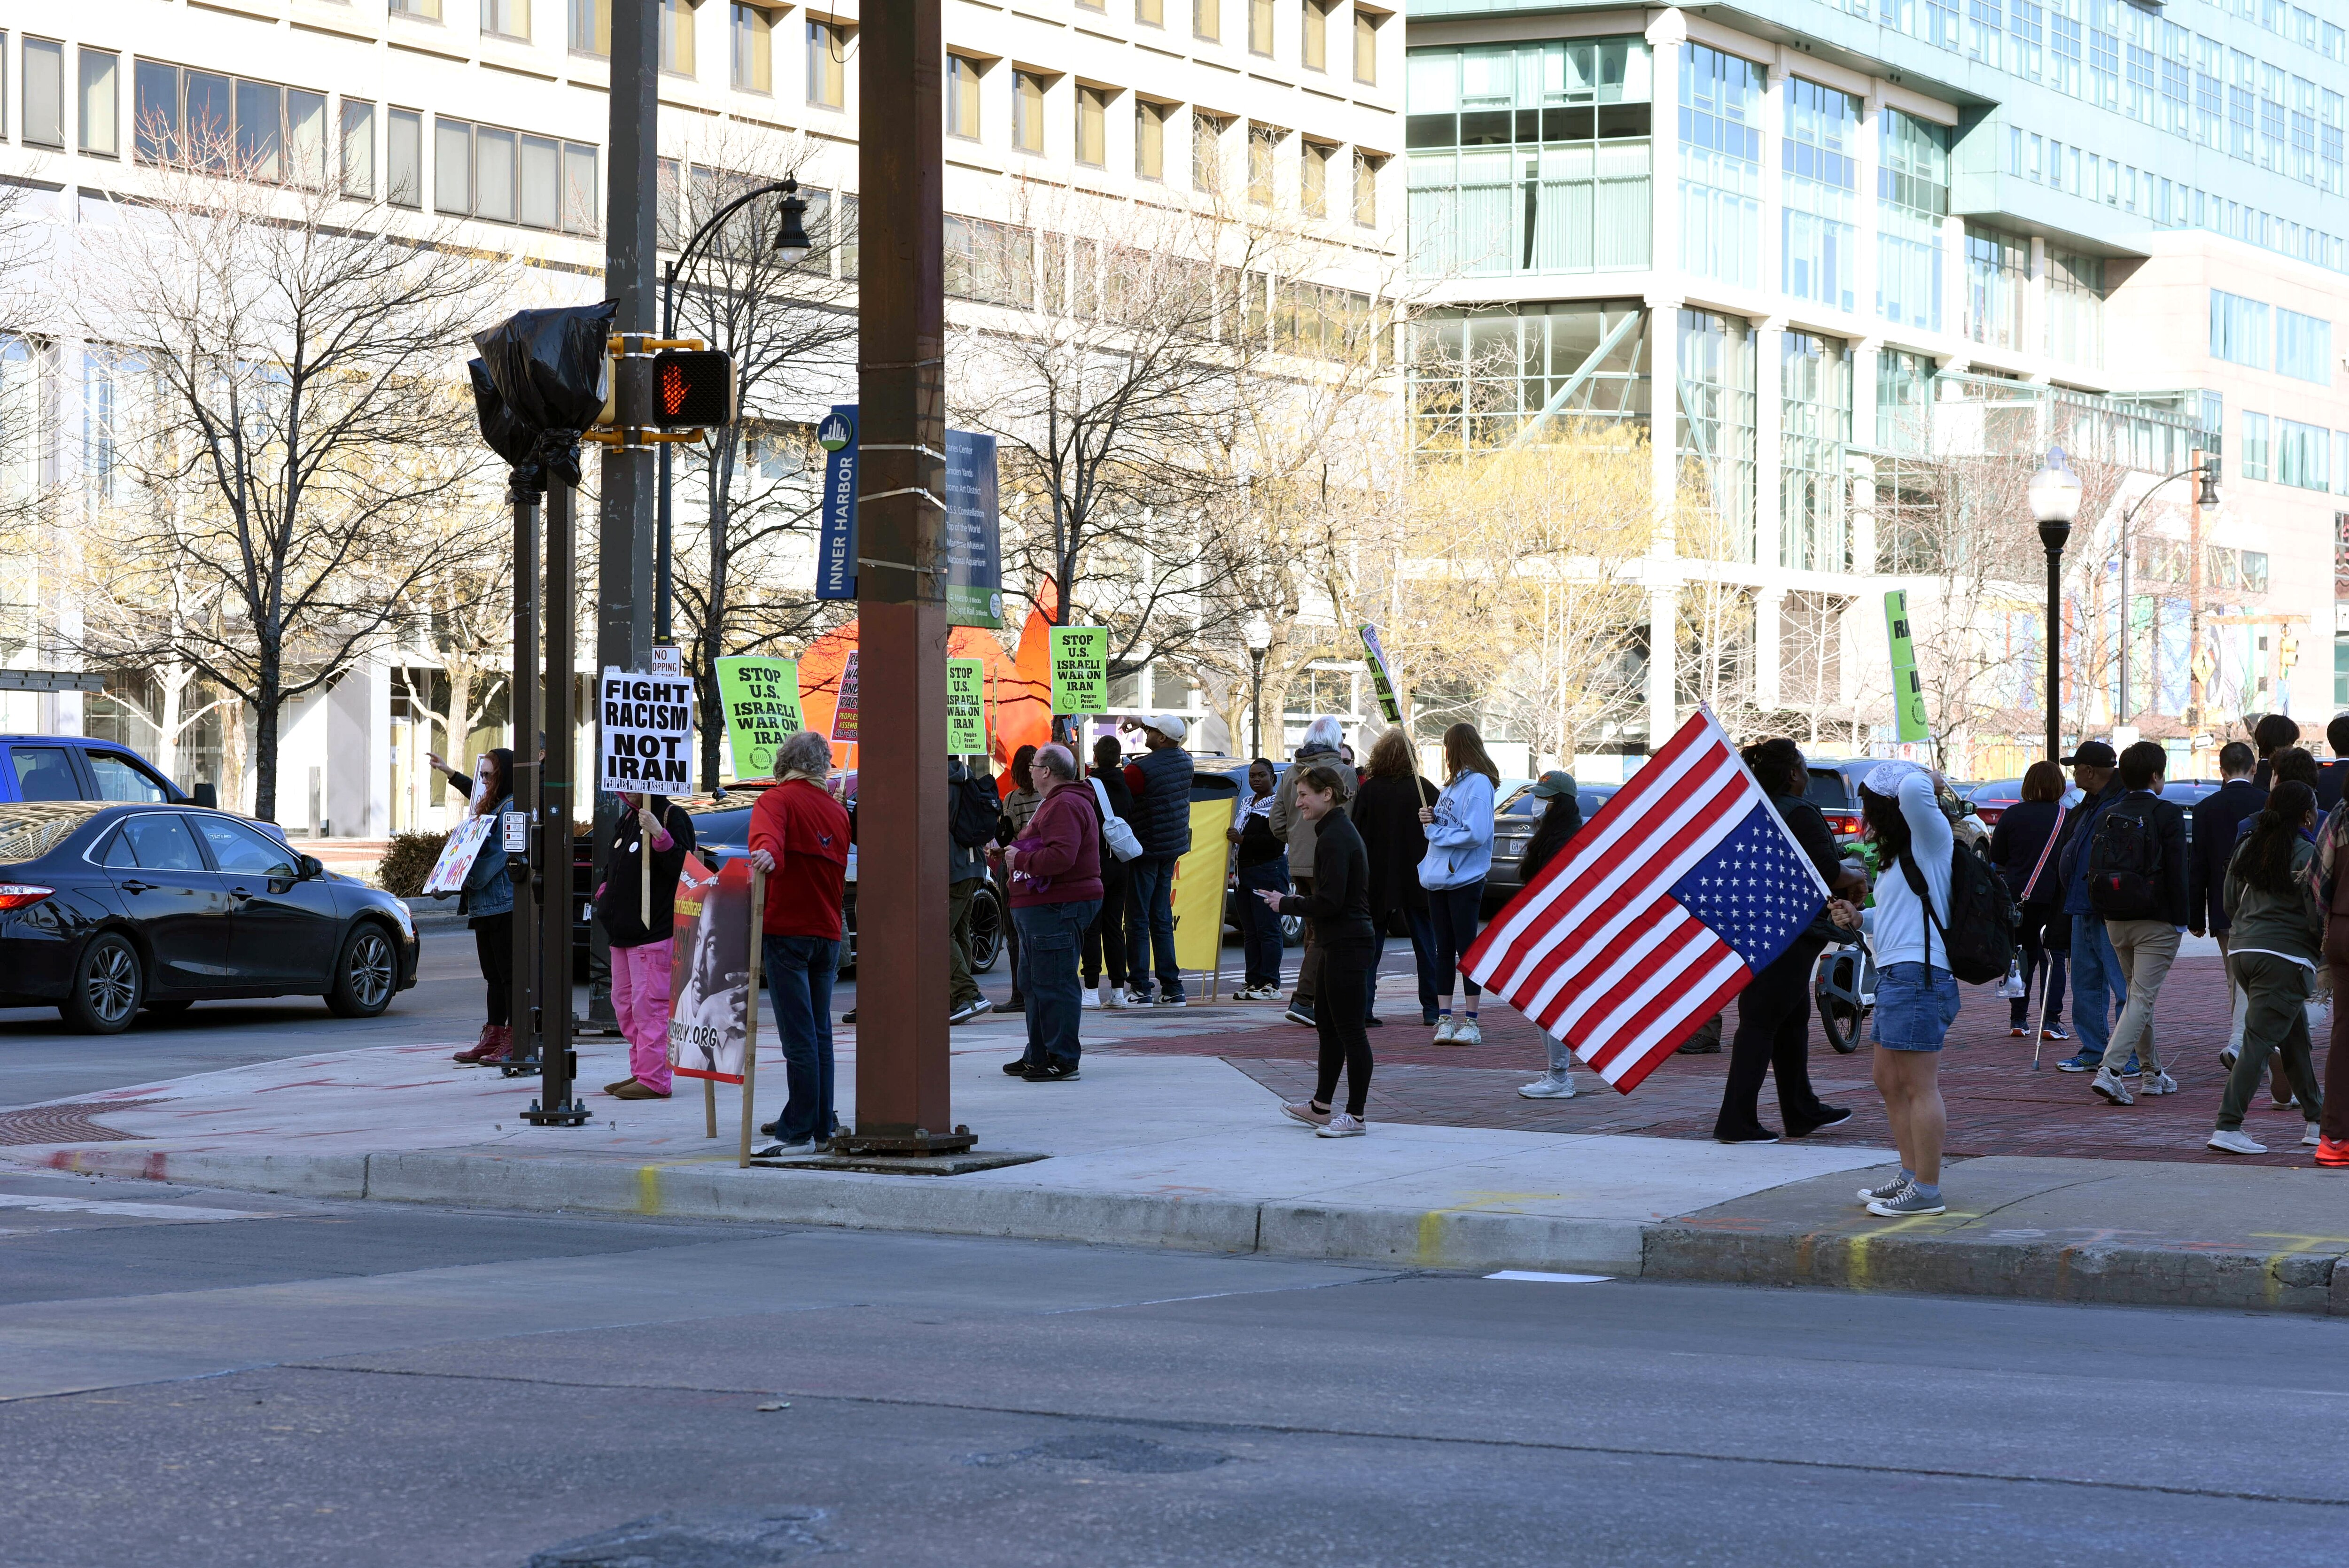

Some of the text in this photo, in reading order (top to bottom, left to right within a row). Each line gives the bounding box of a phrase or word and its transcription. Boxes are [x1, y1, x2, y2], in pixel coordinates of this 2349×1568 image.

[945, 442, 972, 454] harles Center
[962, 468, 973, 477] Yards
[834, 457, 853, 530] HARBOR
[967, 485, 981, 495] District
[958, 507, 984, 518] Constellation
[968, 524, 980, 533] World
[947, 538, 985, 550] Maritime Museum
[829, 537, 846, 590] INNER
[947, 555, 986, 567] National Aquarium
[955, 594, 968, 603] Metro
[1893, 619, 1911, 639] RA
[1062, 635, 1094, 645] STOP
[654, 650, 667, 660] NO
[1068, 647, 1089, 657] U.S.
[849, 654, 858, 666] RE
[1057, 660, 1100, 670] ISRAELI
[653, 662, 677, 672] OPPING
[949, 668, 972, 678] STOP
[738, 668, 781, 683] STOP
[844, 668, 858, 680] WA
[1057, 671, 1101, 680] WAR ON
[605, 680, 689, 704] FIGHT
[749, 684, 780, 699] U.S.
[953, 681, 970, 692] U.S.
[1067, 682, 1094, 691] IRAN
[839, 696, 858, 709] RAC
[947, 695, 979, 705] ISRAELI
[605, 701, 688, 731] RACISM
[733, 702, 796, 718] ISRAELI
[947, 707, 980, 716] WAR ON
[736, 717, 798, 731] WAR ON
[953, 719, 974, 729] IRAN
[754, 731, 788, 744] IRA
[614, 733, 681, 759] NOT
[754, 754, 769, 763] PPA
[608, 755, 686, 783] IRAN
[605, 778, 689, 793] PEOPLES POWER ASSEMBLY.ORG
[447, 818, 493, 846] MAKE ART
[443, 854, 472, 886] WAR
[680, 896, 702, 917] healthcare
